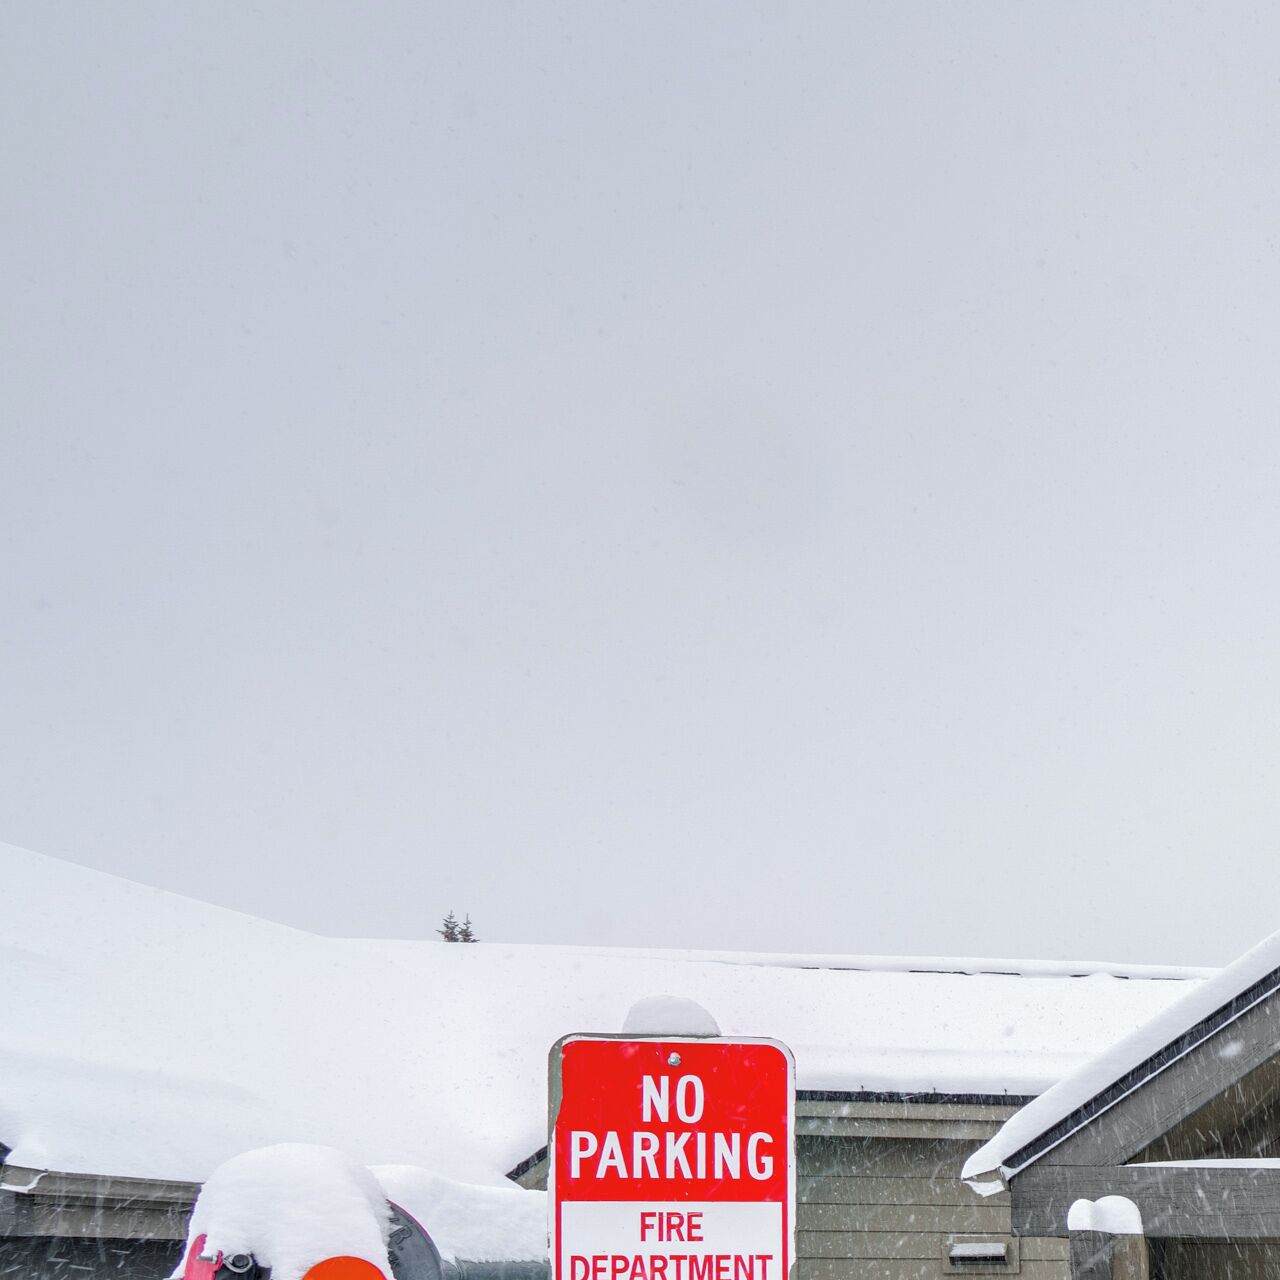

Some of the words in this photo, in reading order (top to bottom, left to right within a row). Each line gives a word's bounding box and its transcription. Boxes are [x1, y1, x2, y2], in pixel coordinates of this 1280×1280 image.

[642, 1074, 705, 1124] NO
[570, 1131, 774, 1181] PARKING
[640, 1211, 704, 1242] FIRE
